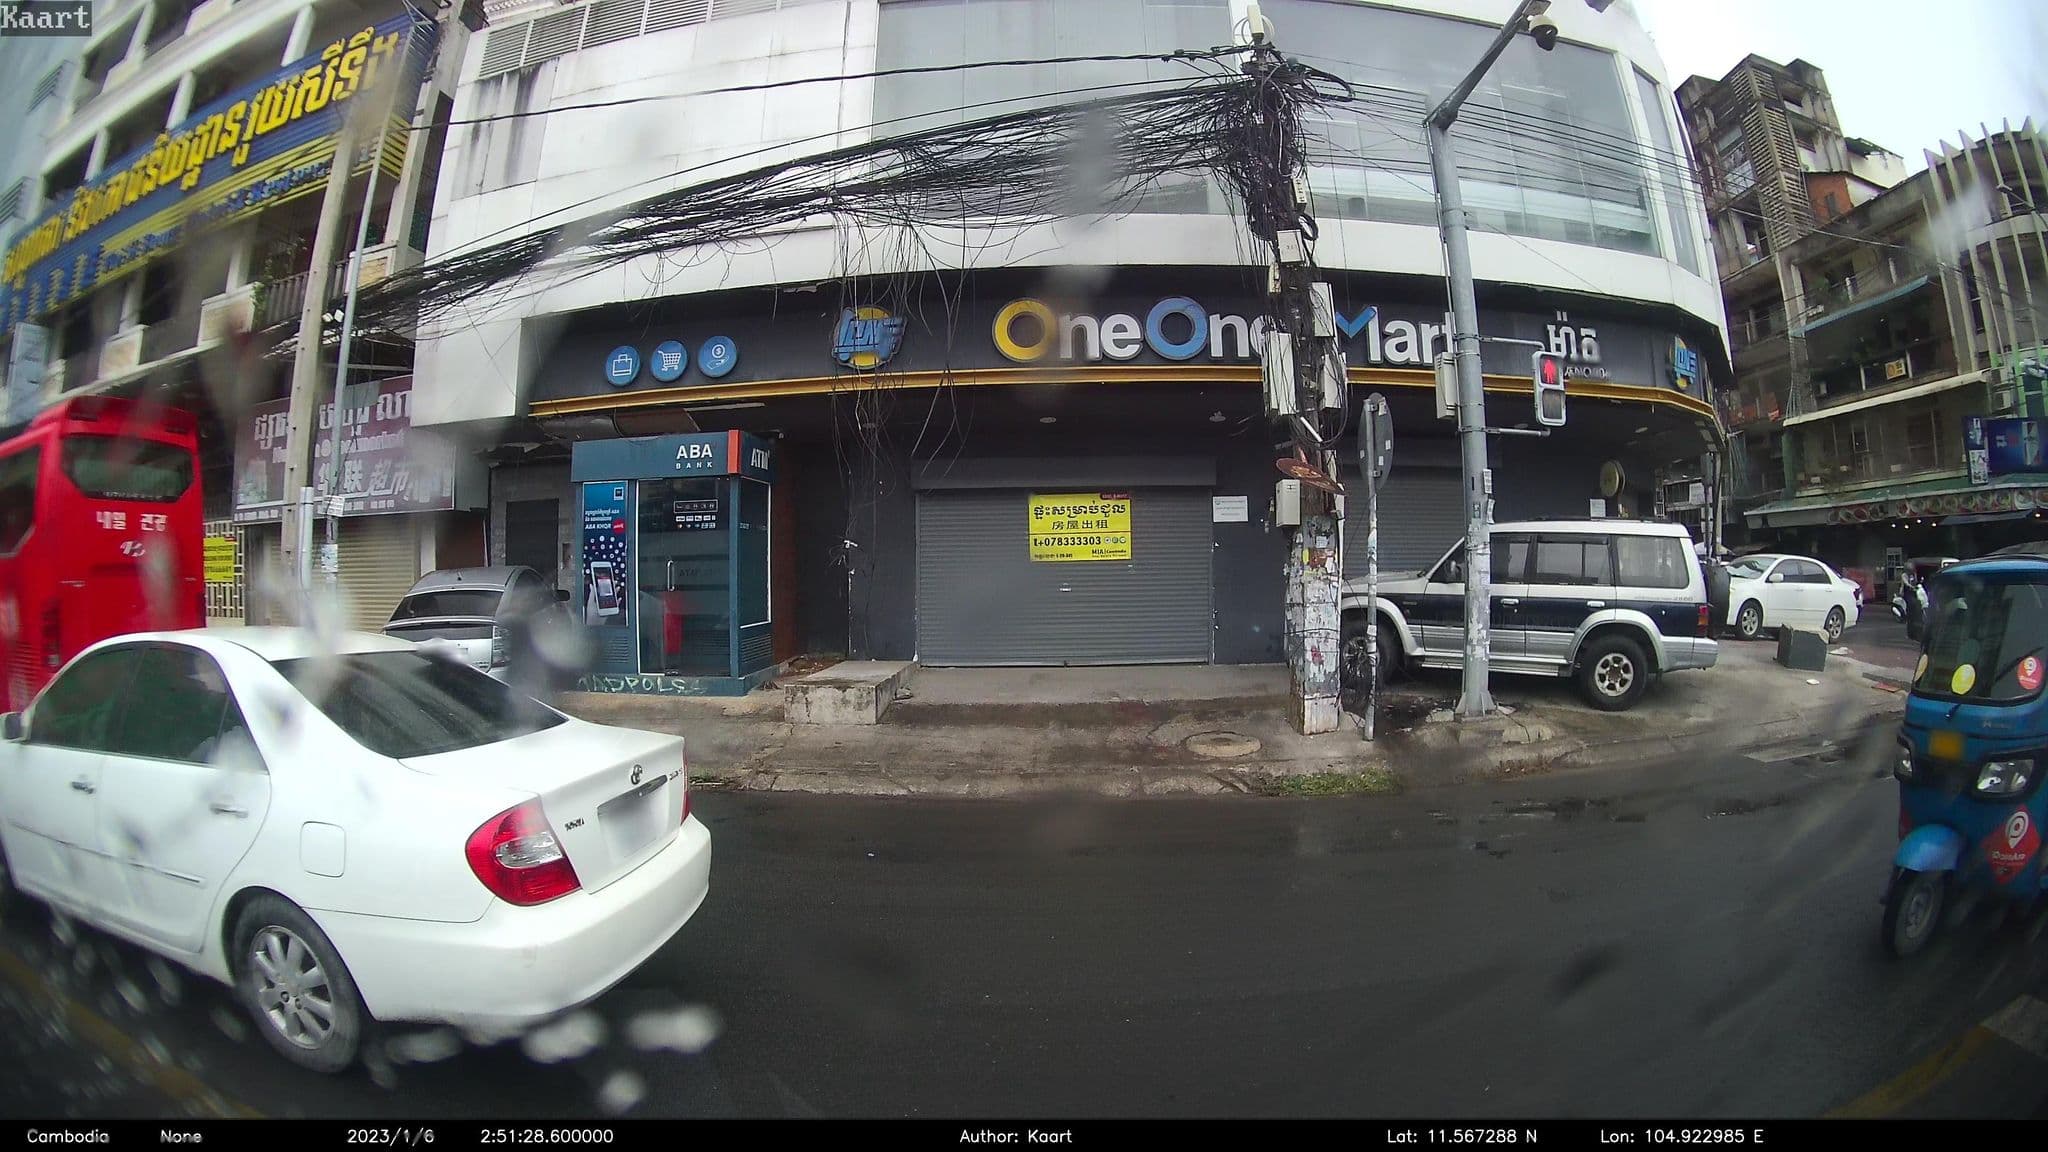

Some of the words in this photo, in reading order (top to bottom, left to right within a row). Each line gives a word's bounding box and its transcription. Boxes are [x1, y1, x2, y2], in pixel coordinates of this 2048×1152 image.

[676, 443, 713, 460] ABA
[675, 461, 713, 470] BANK
[751, 448, 769, 470] ATM
[1052, 519, 1109, 530] 房屋出租
